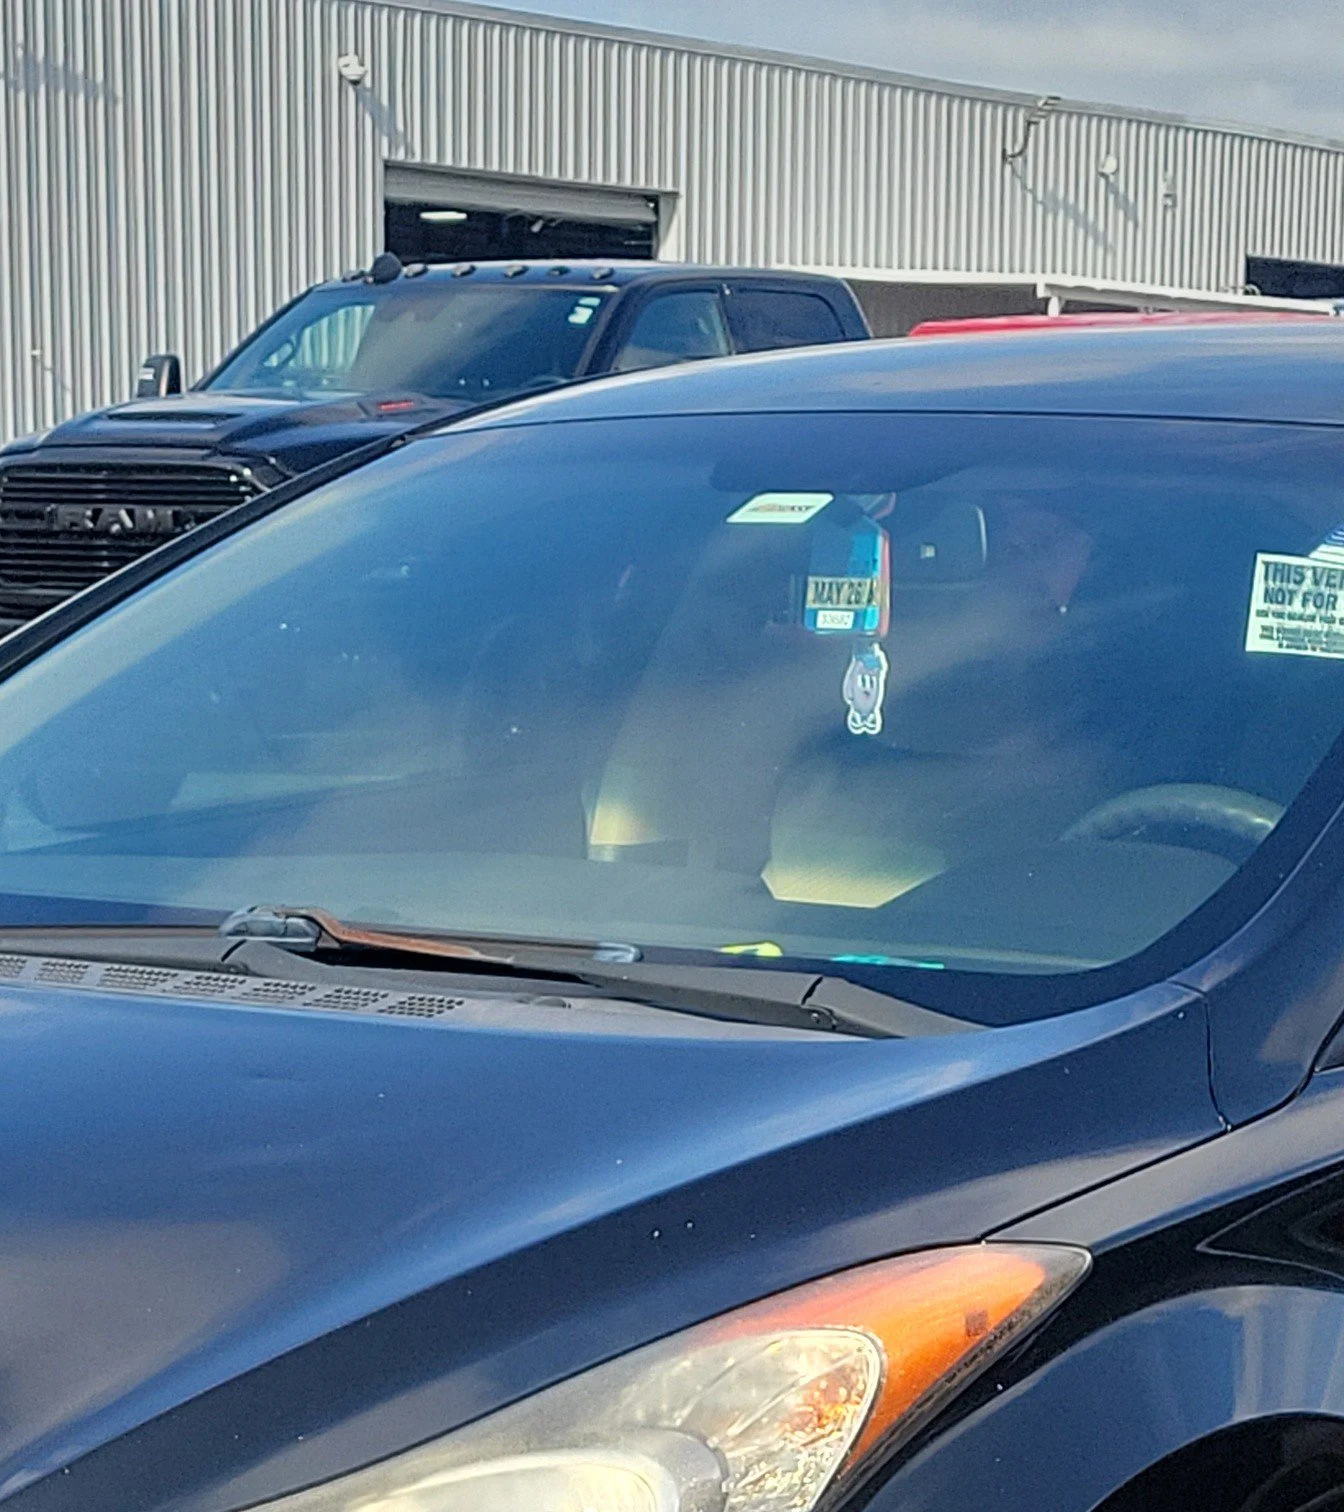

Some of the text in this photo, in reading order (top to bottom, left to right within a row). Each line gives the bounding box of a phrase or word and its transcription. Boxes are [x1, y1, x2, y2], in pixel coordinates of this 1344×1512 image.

[57, 503, 174, 533] RAM
[1262, 560, 1305, 585] THIS
[812, 580, 843, 604] MAY
[1263, 587, 1296, 606] NOT
[1301, 590, 1338, 611] FOR
